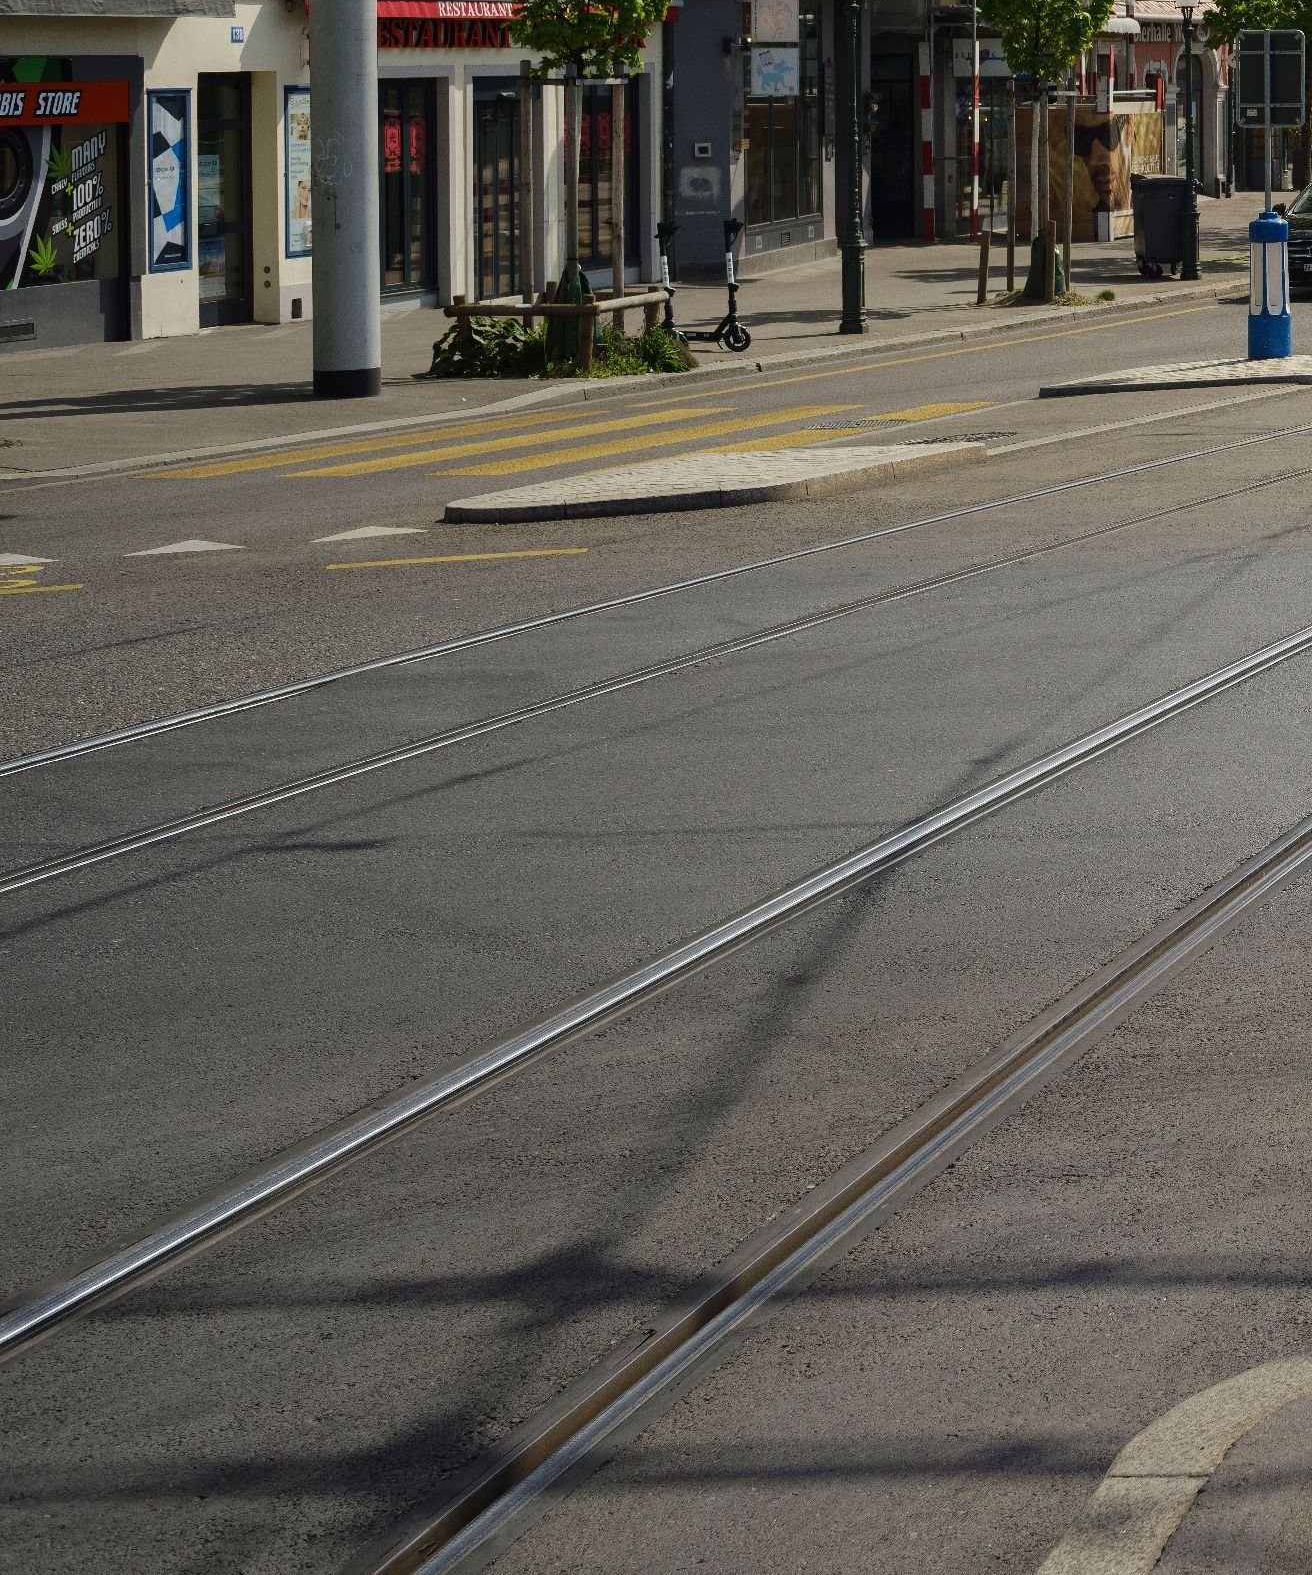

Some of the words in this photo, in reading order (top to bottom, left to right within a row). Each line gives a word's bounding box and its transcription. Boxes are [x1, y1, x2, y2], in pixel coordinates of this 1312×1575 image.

[438, 0, 513, 17] RESTAURANT
[378, 19, 511, 49] ESTAURANT
[0, 92, 25, 116] BIS
[35, 90, 81, 116] STORE
[71, 129, 107, 172] MANY
[51, 177, 68, 195] CRAZY
[72, 173, 104, 212] 100%
[52, 217, 68, 236] SWISS
[73, 207, 113, 253] ZERO%
